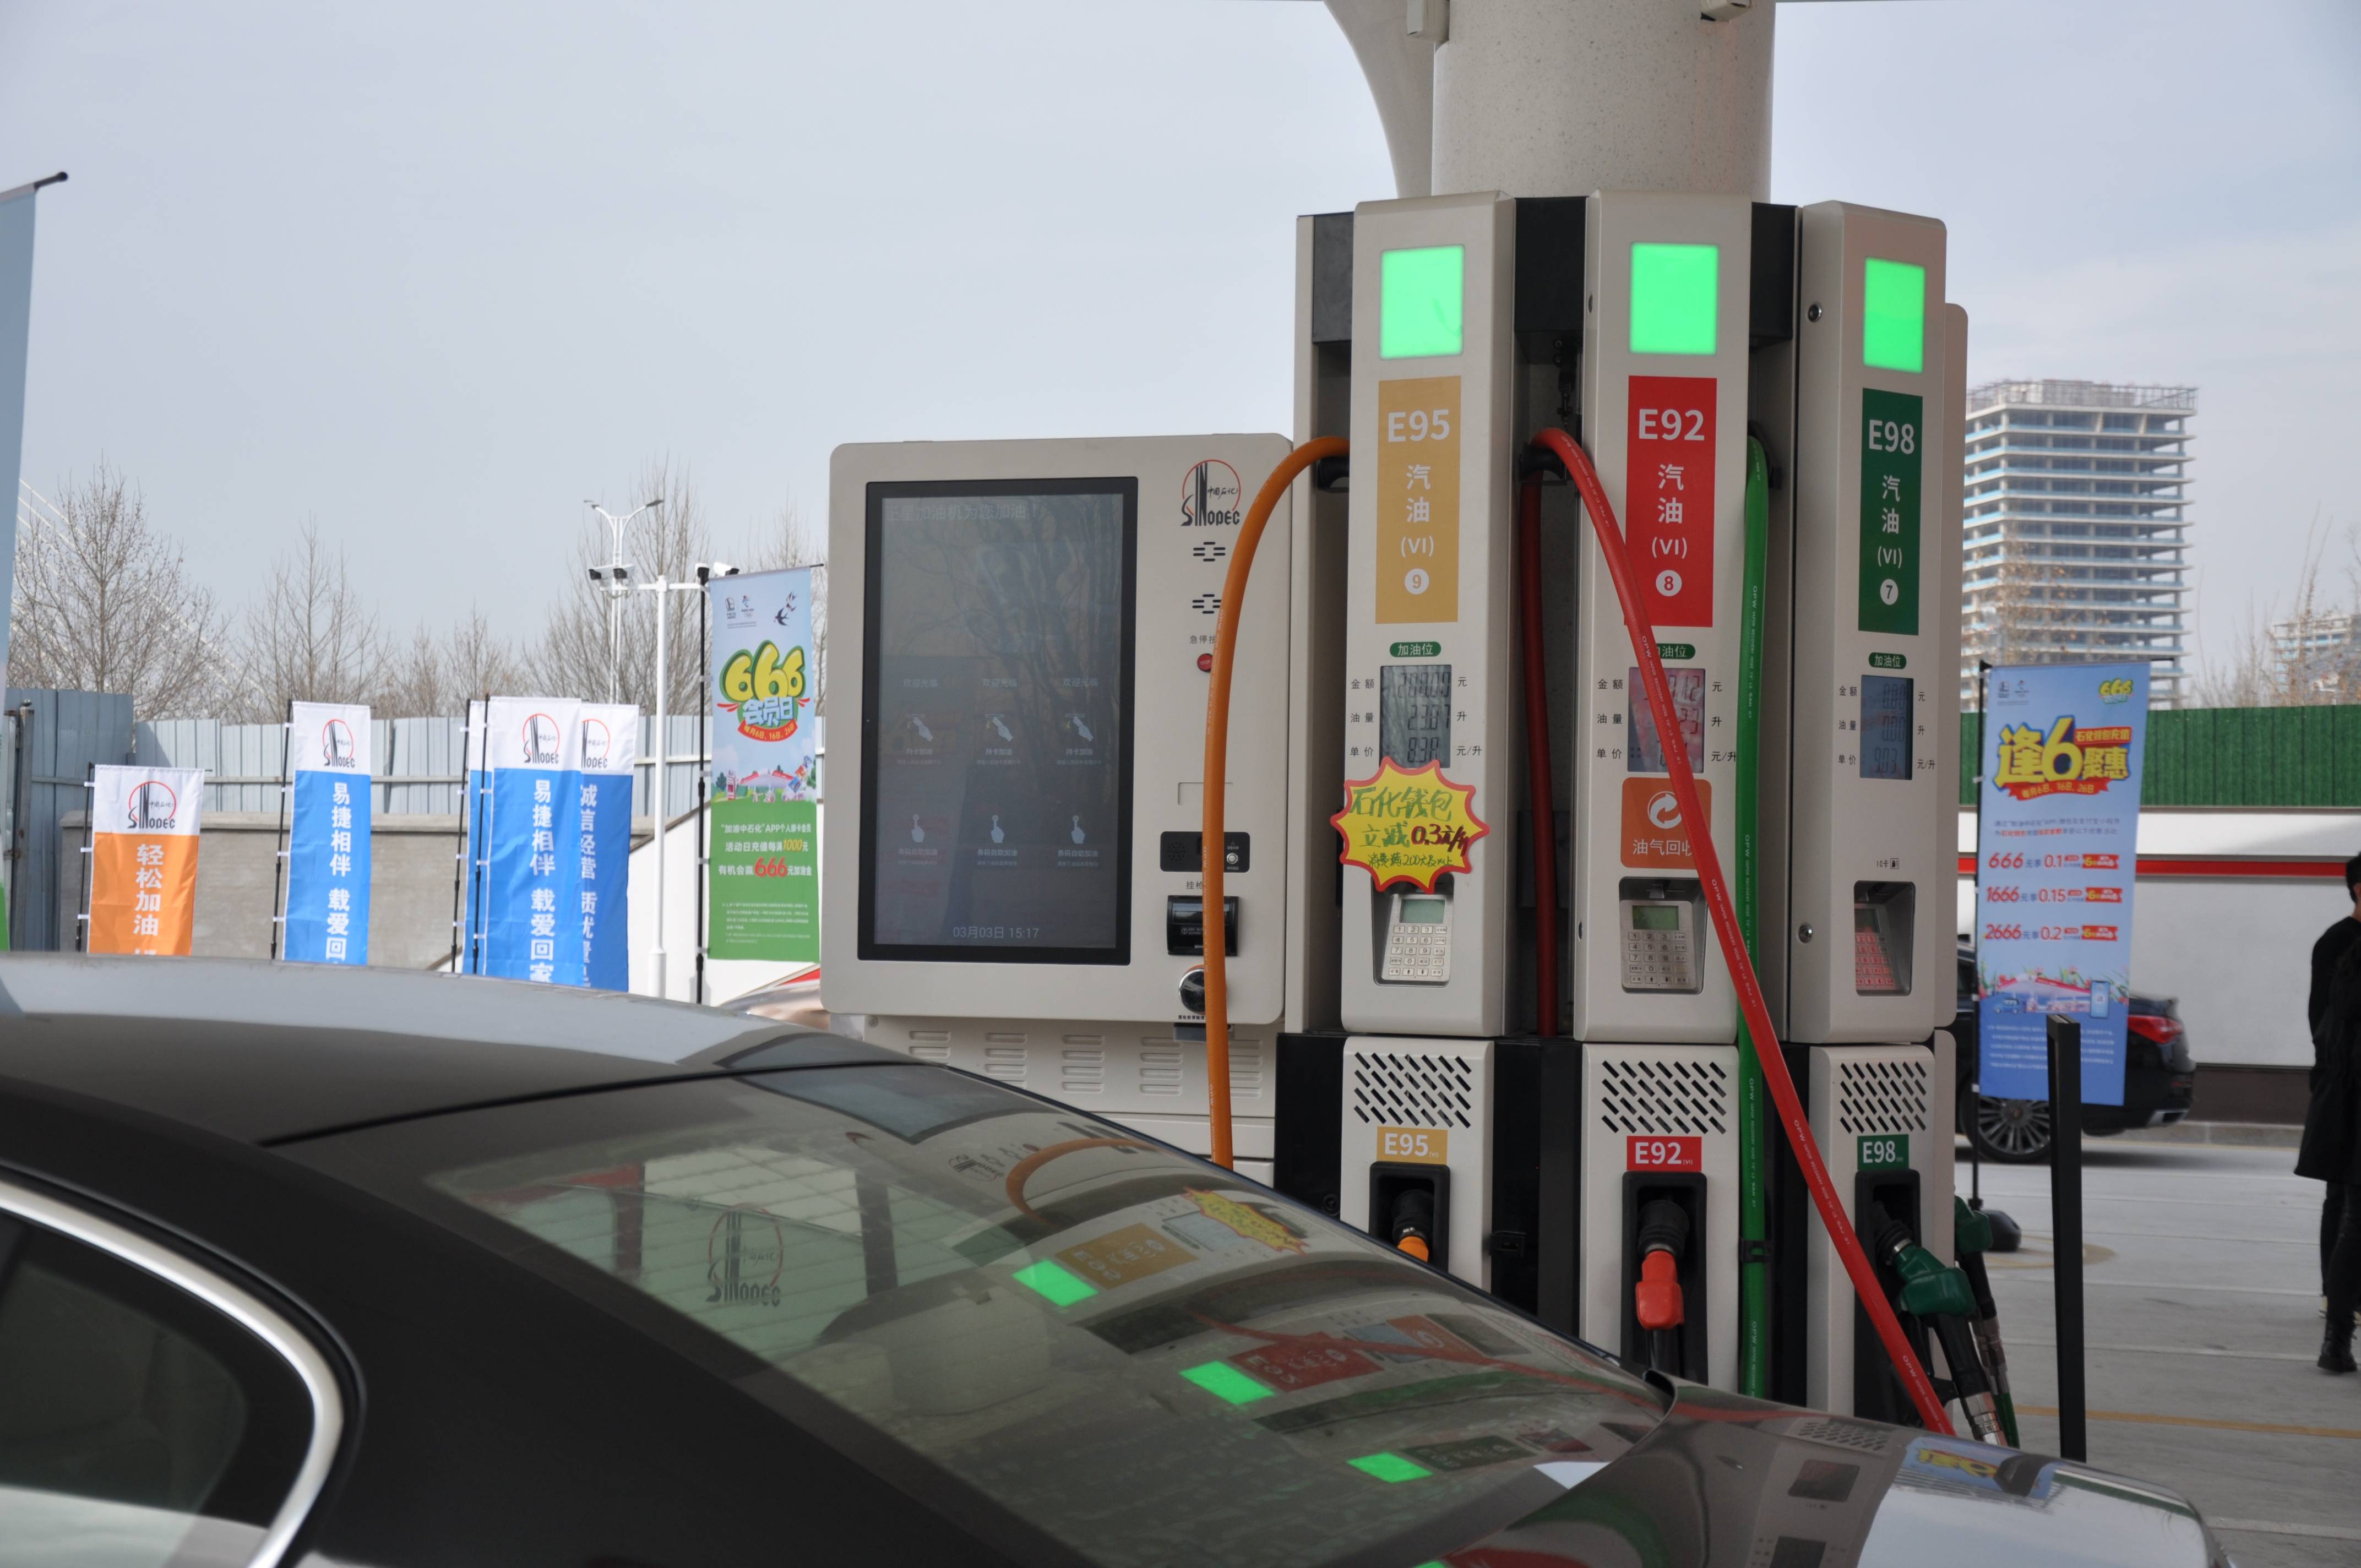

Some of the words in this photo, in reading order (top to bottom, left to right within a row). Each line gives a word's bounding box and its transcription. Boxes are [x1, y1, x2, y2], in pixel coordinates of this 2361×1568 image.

[1388, 409, 1450, 443] E95
[1639, 408, 1705, 441] E92
[1869, 419, 1914, 454] E98
[1180, 462, 1241, 526] SINOPEC
[1207, 486, 1238, 499] 中国石化
[1405, 464, 1431, 524] 汽油
[1658, 464, 1684, 524] 汽油
[1882, 475, 1901, 534] 汽油
[1400, 536, 1434, 558] (VI)
[1651, 537, 1688, 559] (VI)
[1878, 546, 1902, 569] (VI)
[1397, 643, 1433, 656] 加油位
[1657, 645, 1687, 658] 油位
[723, 641, 804, 703] 666
[1641, 635, 1652, 658] OPW
[1653, 677, 1664, 702] RECOVERY
[1874, 655, 1901, 667] 加油位
[1351, 679, 1375, 689] 金额
[1457, 677, 1467, 688] 元
[1597, 679, 1624, 689] 金额
[1712, 682, 1722, 692] 元
[1839, 685, 1857, 696] 金额
[2099, 679, 2132, 696] 666
[1918, 692, 1925, 701] 元
[742, 696, 795, 727] 会员日
[1350, 712, 1374, 723] 油量
[1456, 711, 1467, 722] 升
[1597, 714, 1623, 725] 油量
[1711, 716, 1722, 727] 升
[1838, 720, 1857, 731] 油量
[1917, 726, 1925, 736] 升
[323, 721, 355, 767] SINOPEC
[524, 715, 559, 764] SINOPEC
[1456, 745, 1482, 756] 元/升
[1350, 747, 1374, 757] 单价
[1597, 749, 1622, 759] 单价
[1711, 751, 1737, 762] 元/升
[1838, 754, 1856, 765] 单价
[1917, 759, 1936, 770] 元/升
[127, 782, 175, 829] SINOPEC
[1349, 786, 1453, 822] 石化钱包
[329, 782, 352, 877] 易捷相伴
[530, 780, 556, 876] 易捷相伴
[134, 844, 164, 936] 轻松加油
[1710, 879, 1722, 901] OPW
[1724, 921, 1736, 945] RECOVERY
[325, 888, 350, 963] 载爱回
[953, 927, 1004, 939] 03月03日
[1009, 928, 1040, 939] 15:17
[1385, 1133, 1428, 1157] E95
[1635, 1142, 1682, 1164] E92
[1863, 1141, 1896, 1164] E98
[1792, 1119, 1807, 1142] OPW
[1810, 1161, 1824, 1185] RECOVERY
[1820, 1186, 1830, 1199] HOSE
[1901, 1354, 1917, 1378] OPW
